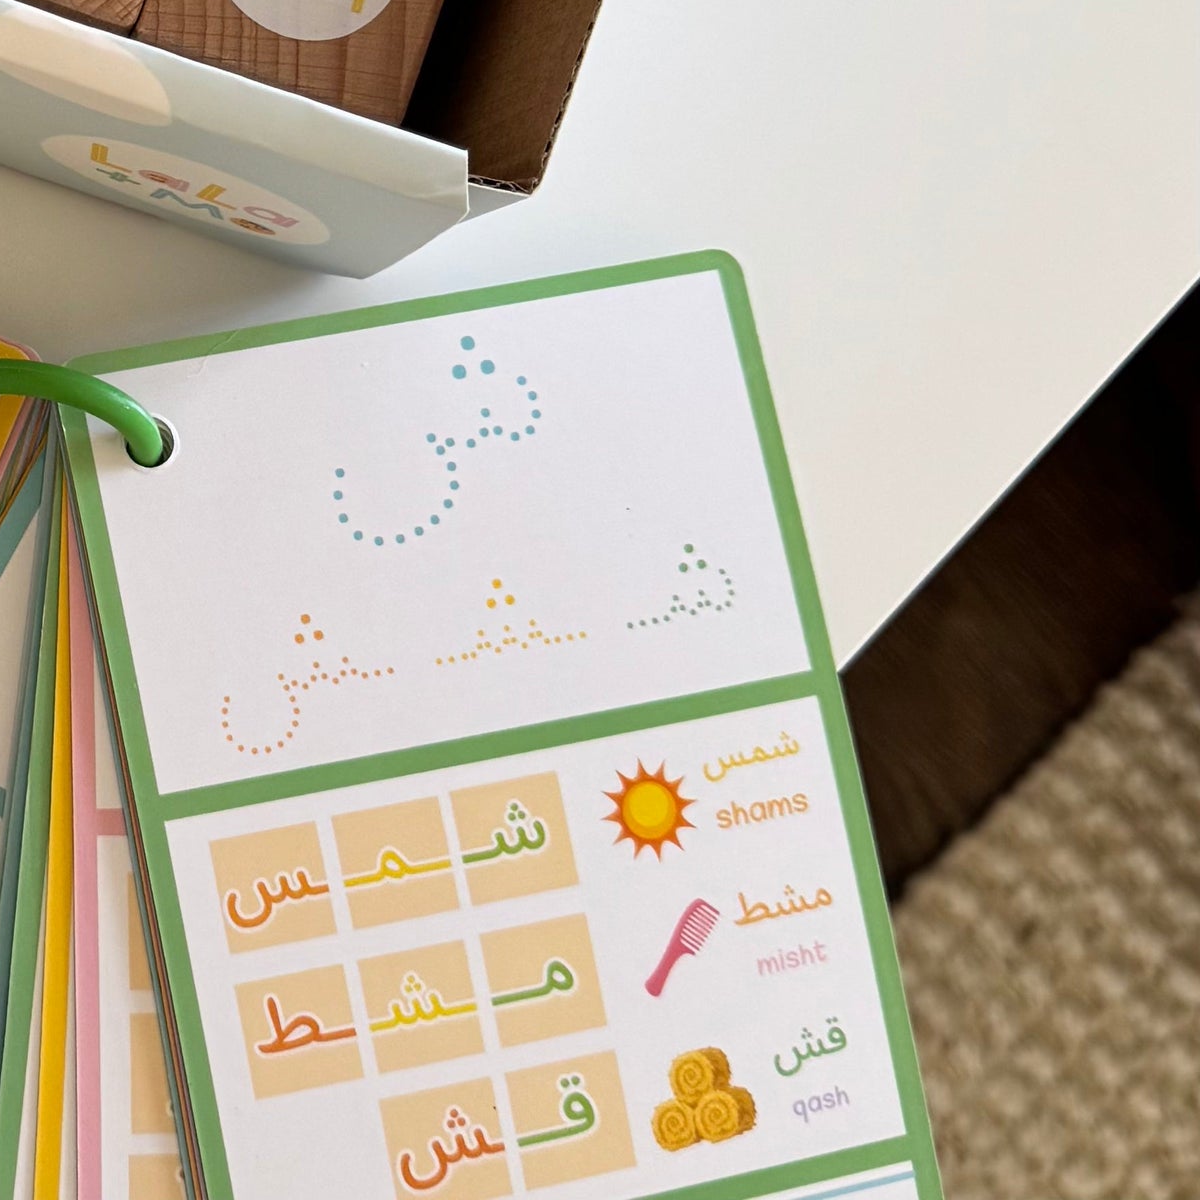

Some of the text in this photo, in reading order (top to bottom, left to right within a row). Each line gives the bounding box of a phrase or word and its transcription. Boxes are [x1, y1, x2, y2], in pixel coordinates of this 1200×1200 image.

[703, 731, 800, 783] شمس
[715, 791, 810, 830] shams
[733, 883, 833, 927] مشط
[756, 939, 828, 977] misht
[773, 1016, 848, 1077] قش
[792, 1086, 851, 1125] qash
